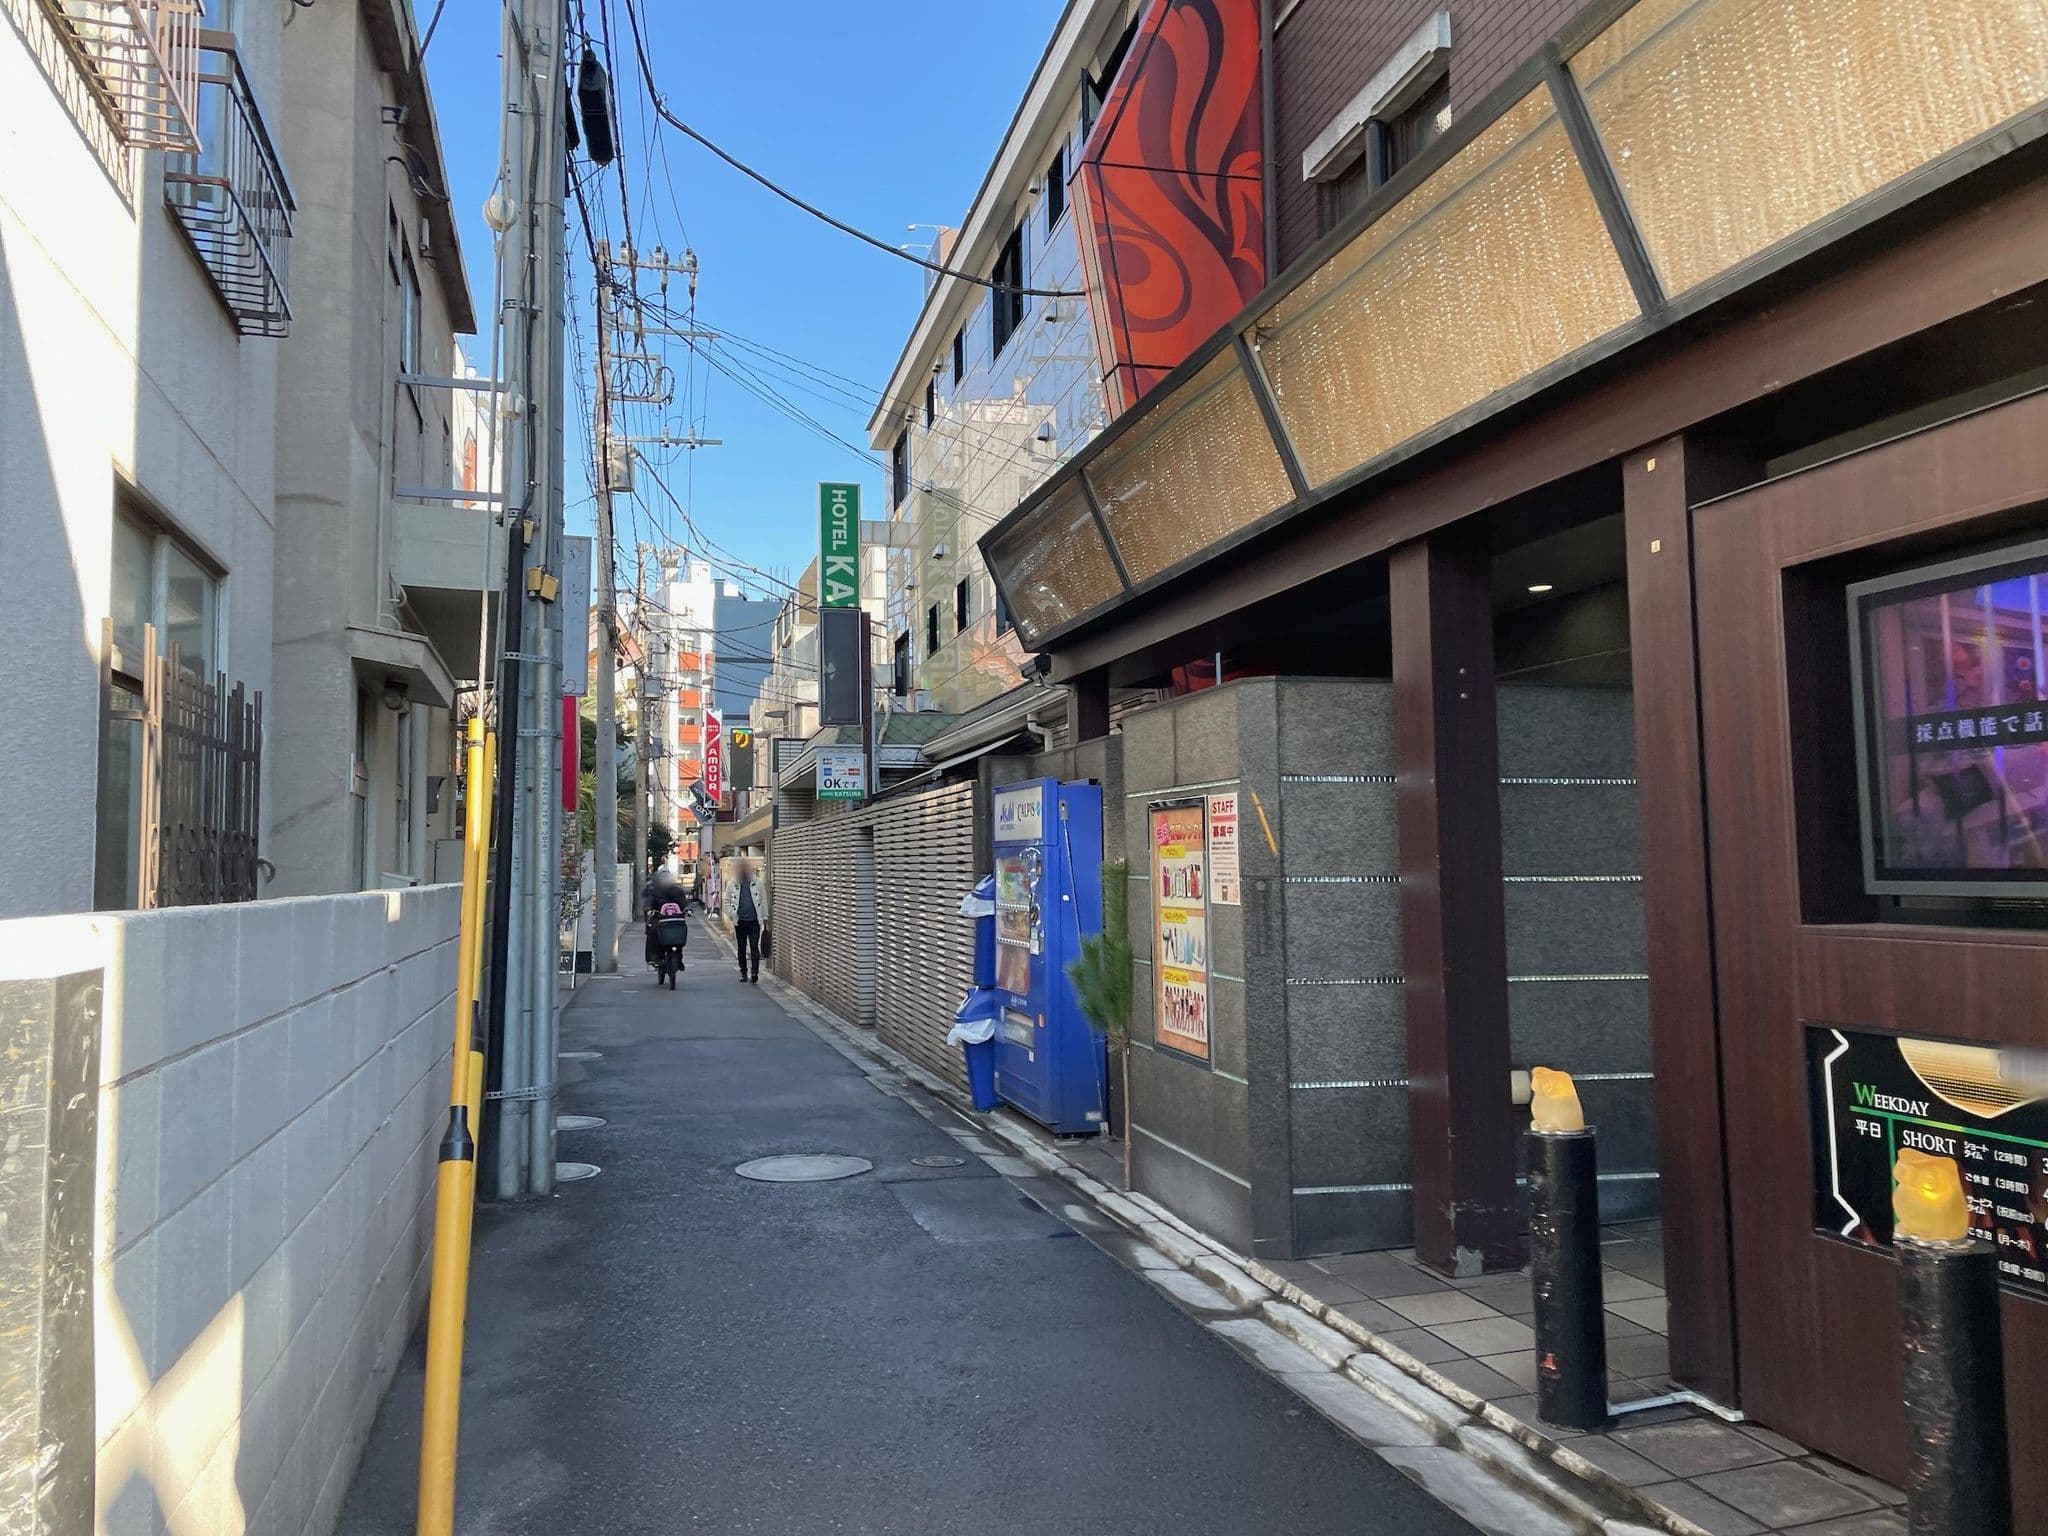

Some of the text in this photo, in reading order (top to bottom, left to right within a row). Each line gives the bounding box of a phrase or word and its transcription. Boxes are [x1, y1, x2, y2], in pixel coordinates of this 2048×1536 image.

[826, 489, 854, 607] HOTEL KA
[1916, 710, 2048, 743] 採点機能で話
[708, 748, 718, 790] AMOUR
[1212, 800, 1234, 814] STAFF
[1855, 1119, 1882, 1138] 平日
[1902, 1129, 1957, 1155] SHORT
